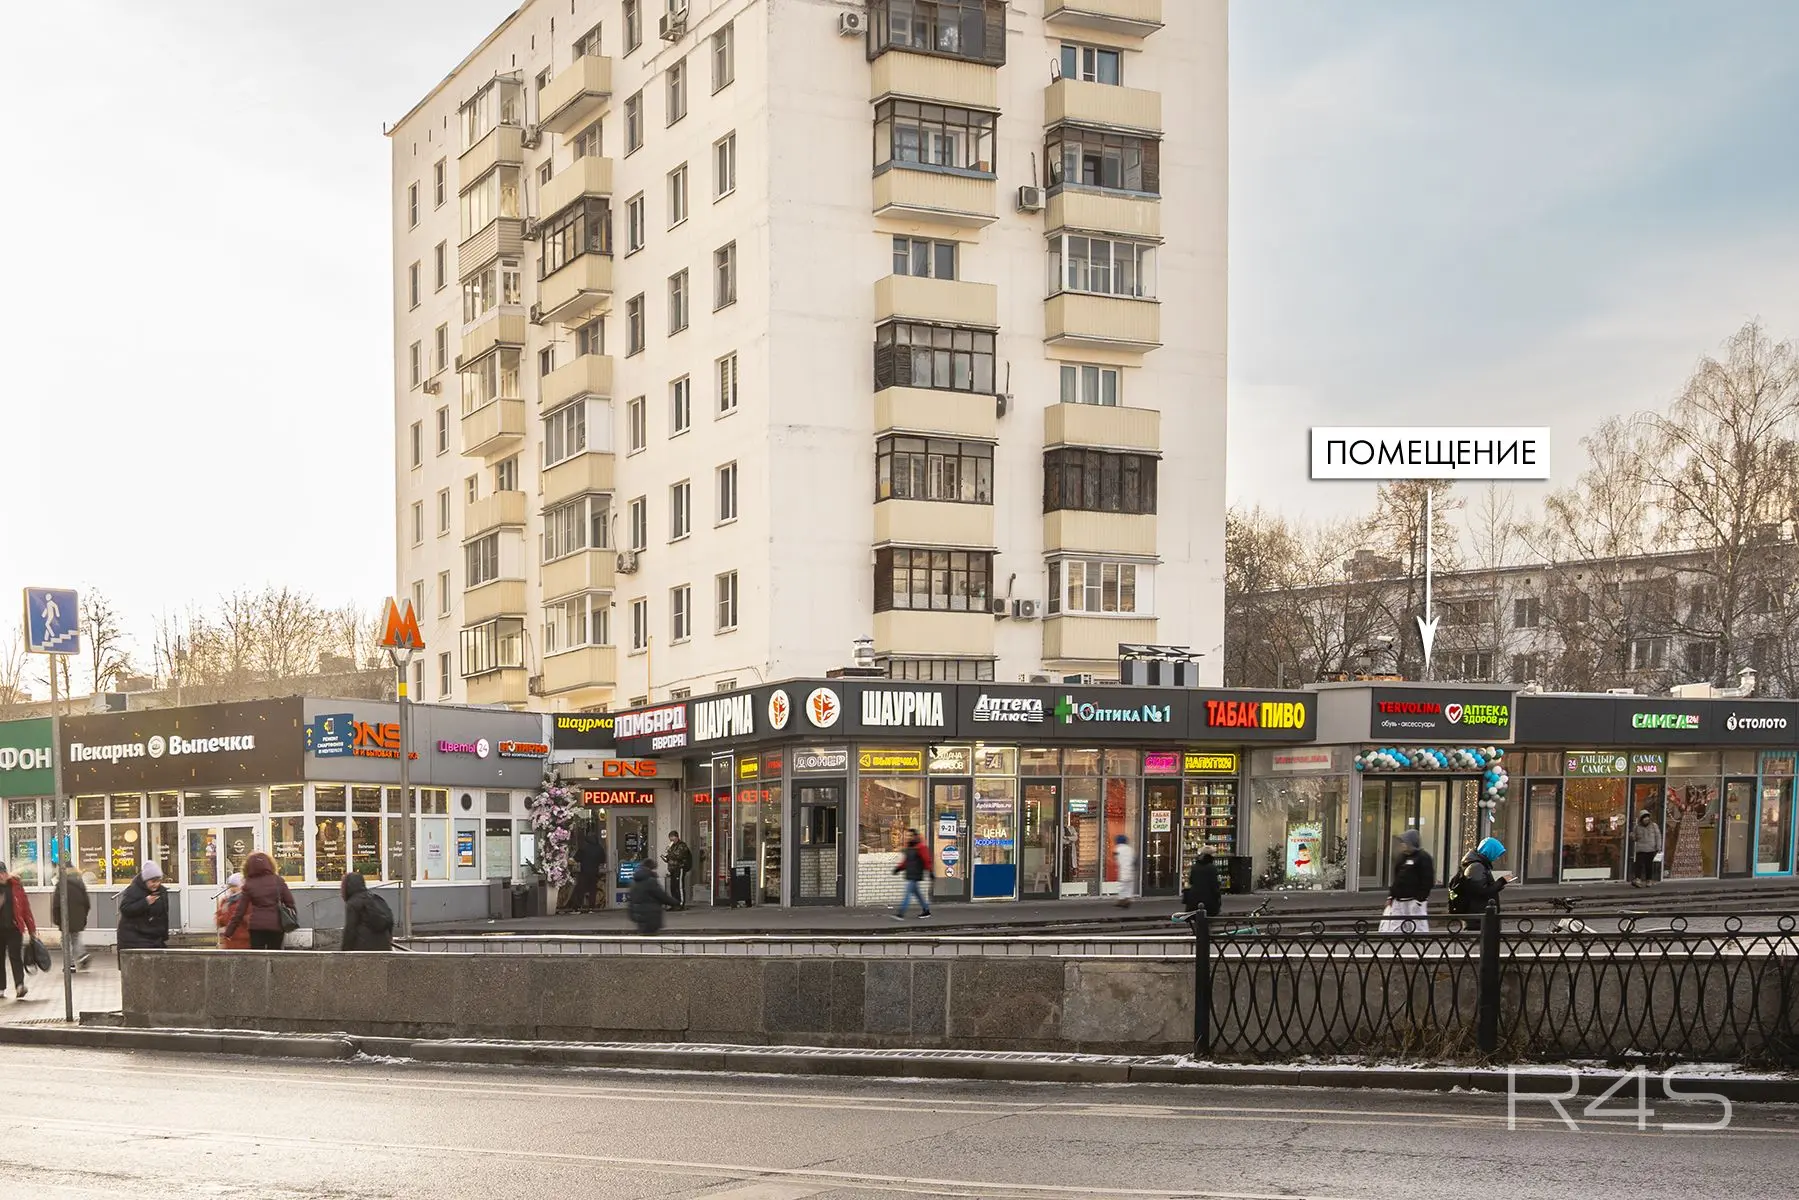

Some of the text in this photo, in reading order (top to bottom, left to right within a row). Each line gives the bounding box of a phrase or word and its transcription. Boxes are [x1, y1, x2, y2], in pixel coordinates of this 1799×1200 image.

[861, 690, 944, 727] ШАУРМА
[1206, 700, 1306, 729] ТАБАК ПИВО
[1379, 701, 1441, 714] TERVOLINA
[1463, 704, 1508, 717] АПТЕКА
[557, 717, 614, 733] шаурма
[613, 705, 687, 738] ЛОМБАРД
[692, 694, 754, 742] ШАУРМА
[1631, 713, 1687, 729] САМСА
[439, 740, 489, 755] Цветы 24
[652, 733, 687, 750] АВРОРА
[70, 734, 255, 765] Пекарня Выпечка
[1185, 757, 1232, 769] НАПИТКИ
[1632, 754, 1663, 763] САМСА
[603, 760, 657, 777] DNS
[1582, 764, 1611, 774] САМСА
[585, 791, 654, 804] PEDANT.ru
[983, 828, 1008, 839] ЦЕНА
[98, 858, 134, 867] БУОЧКИ
